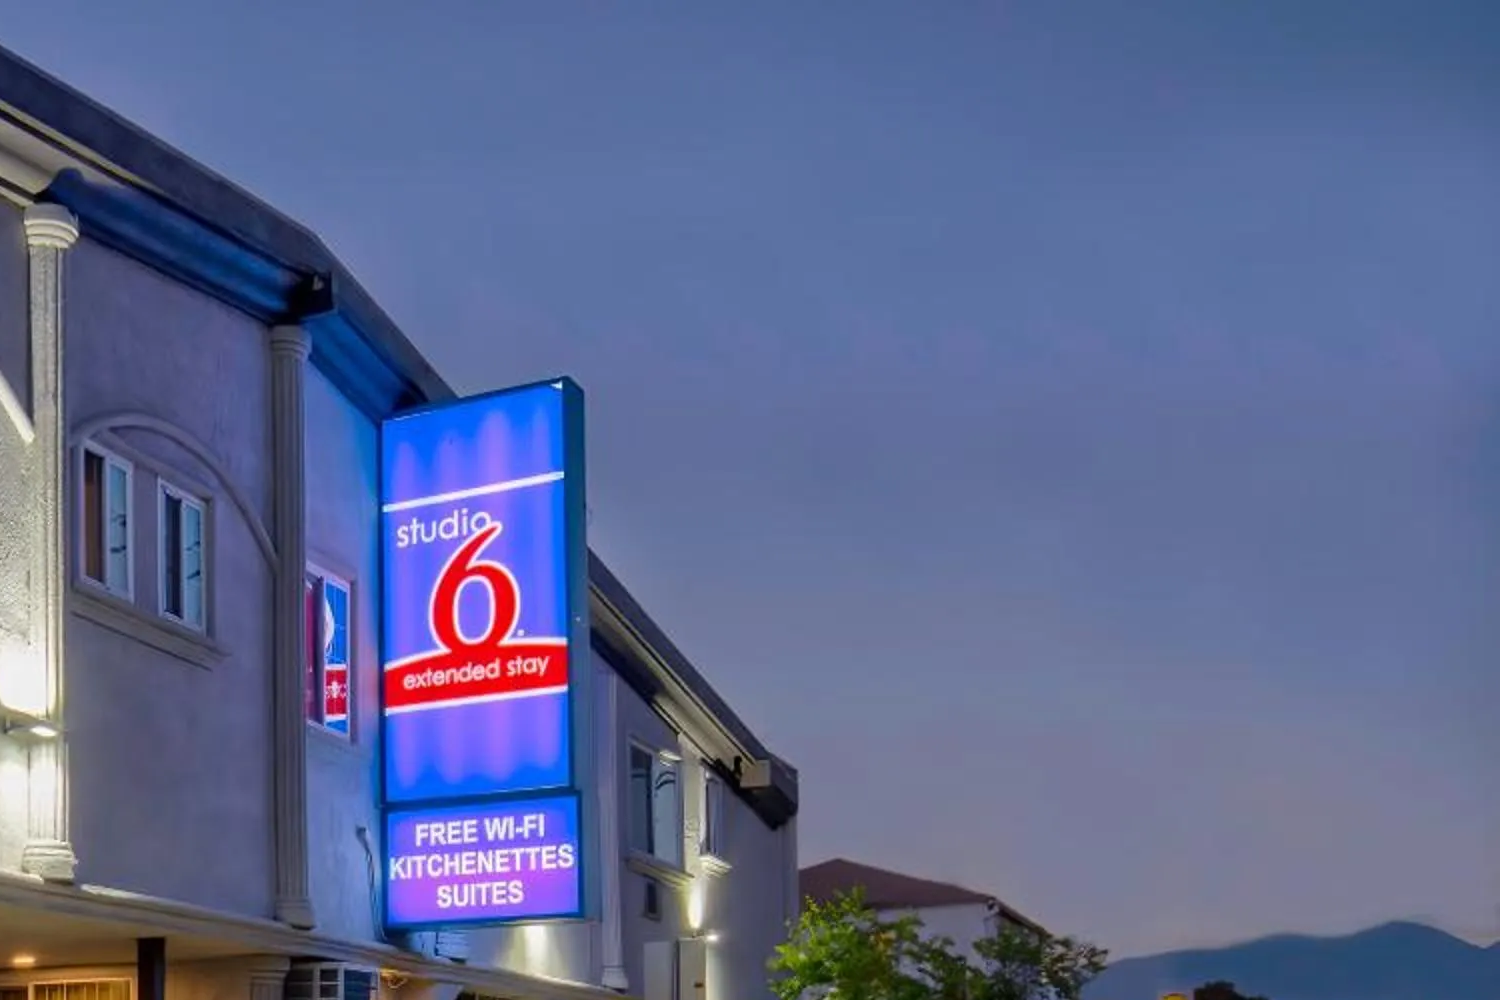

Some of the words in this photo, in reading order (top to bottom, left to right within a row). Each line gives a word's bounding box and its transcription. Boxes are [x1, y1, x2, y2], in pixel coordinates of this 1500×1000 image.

[396, 508, 491, 547] studio
[428, 521, 520, 651] 6
[403, 658, 500, 690] extended
[506, 655, 549, 677] stay
[415, 820, 478, 847] FREE
[484, 814, 545, 841] WI-FI
[389, 844, 574, 881] KITCHENETTES
[436, 880, 524, 909] SUITES
